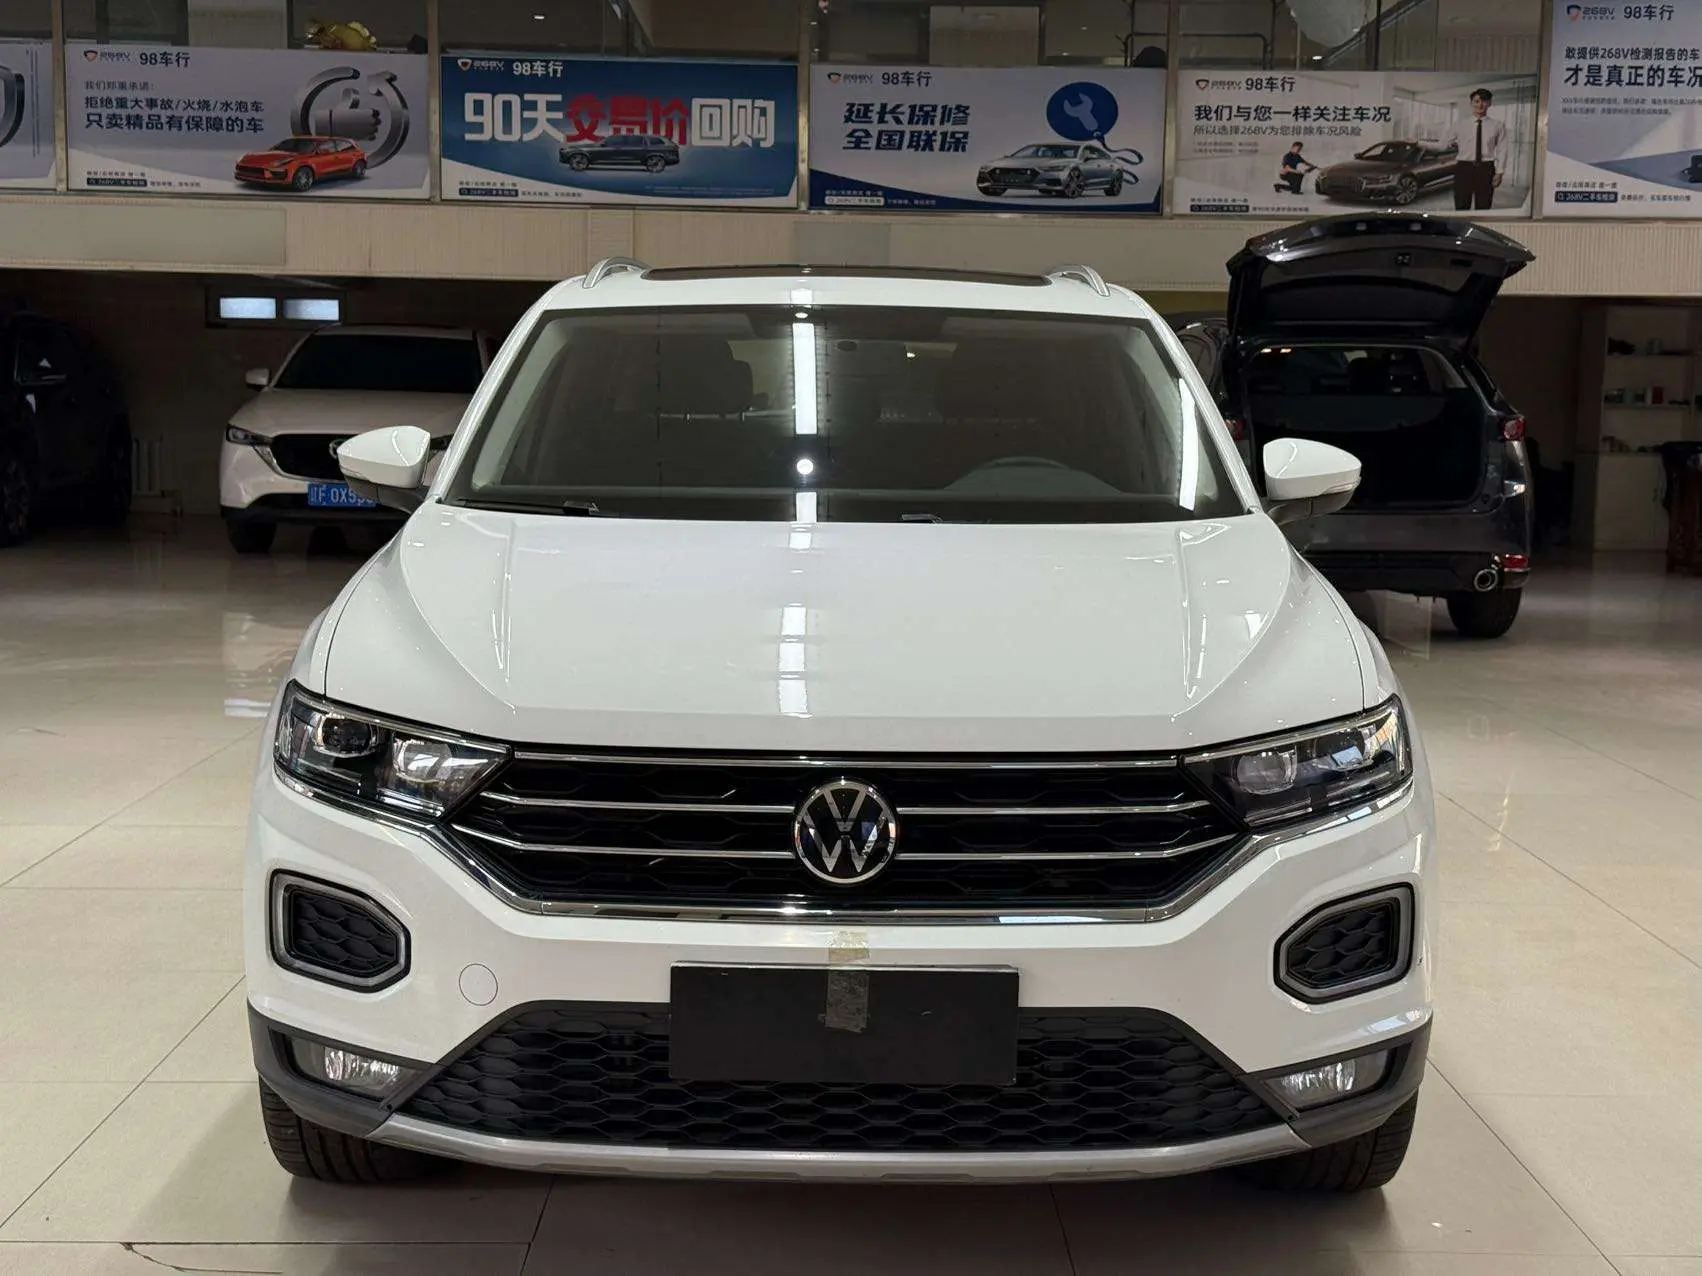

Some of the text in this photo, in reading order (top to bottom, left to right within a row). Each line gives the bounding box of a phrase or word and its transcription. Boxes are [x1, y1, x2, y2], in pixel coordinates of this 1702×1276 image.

[1623, 4, 1674, 21] 98车行
[139, 51, 190, 68] 98车行
[1565, 46, 1700, 61] 敢提供268V检测报告的车
[513, 61, 563, 78] 98车行
[1564, 64, 1702, 87] 才是真正的车况
[881, 71, 932, 87] 98车行
[1245, 76, 1296, 92] 98车行
[84, 96, 265, 113] 拒绝重大事故/火烧/水泡车
[464, 92, 776, 147] 90天交易价回购
[843, 102, 970, 126] 延长保修
[1194, 104, 1392, 123] 我们与您一样关注车况
[84, 113, 265, 134] 只卖精品有保障的车
[1193, 125, 1363, 137] 所以选择268V为您排除车况风险
[842, 128, 970, 153] 全国联保
